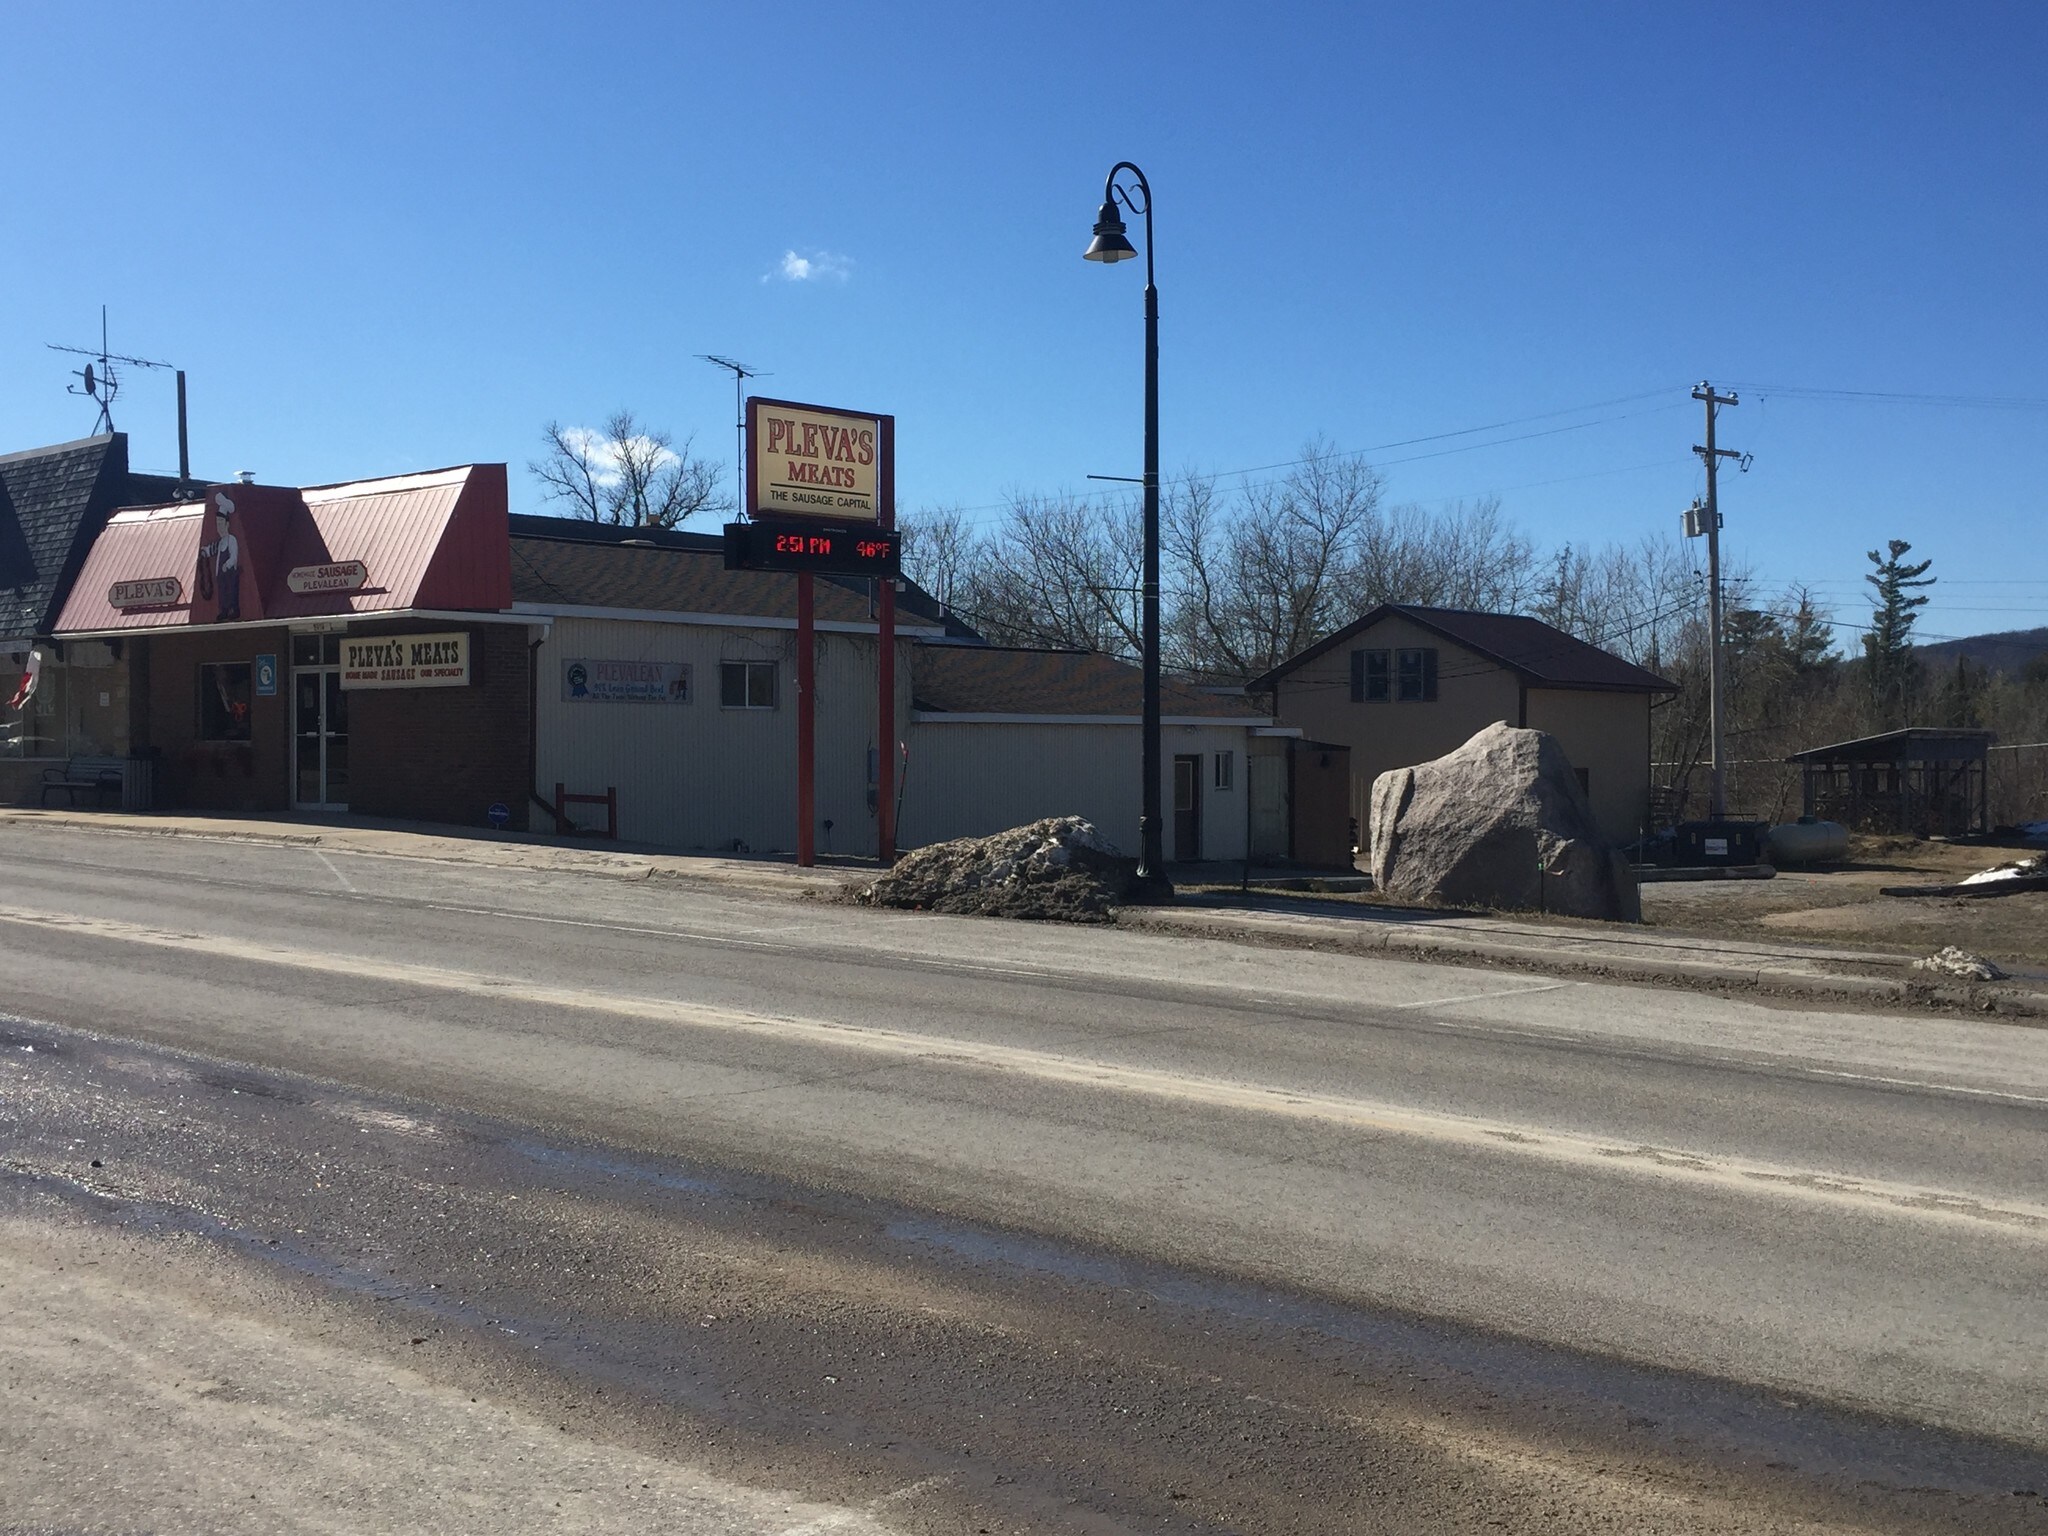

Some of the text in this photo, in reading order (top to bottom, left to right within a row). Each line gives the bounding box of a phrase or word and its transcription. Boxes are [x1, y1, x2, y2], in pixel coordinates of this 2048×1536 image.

[767, 418, 874, 465] PLEVA'S
[788, 461, 855, 488] MEATS
[770, 489, 871, 510] THE SAUSAGE CAPITAL
[809, 537, 831, 555] PM
[317, 564, 358, 579] SAUSAGE
[303, 577, 350, 591] PLEVALEAN
[349, 639, 459, 668] PLEVA'S MEATS
[381, 667, 417, 682] SAUSAGE
[419, 668, 433, 679] OUR
